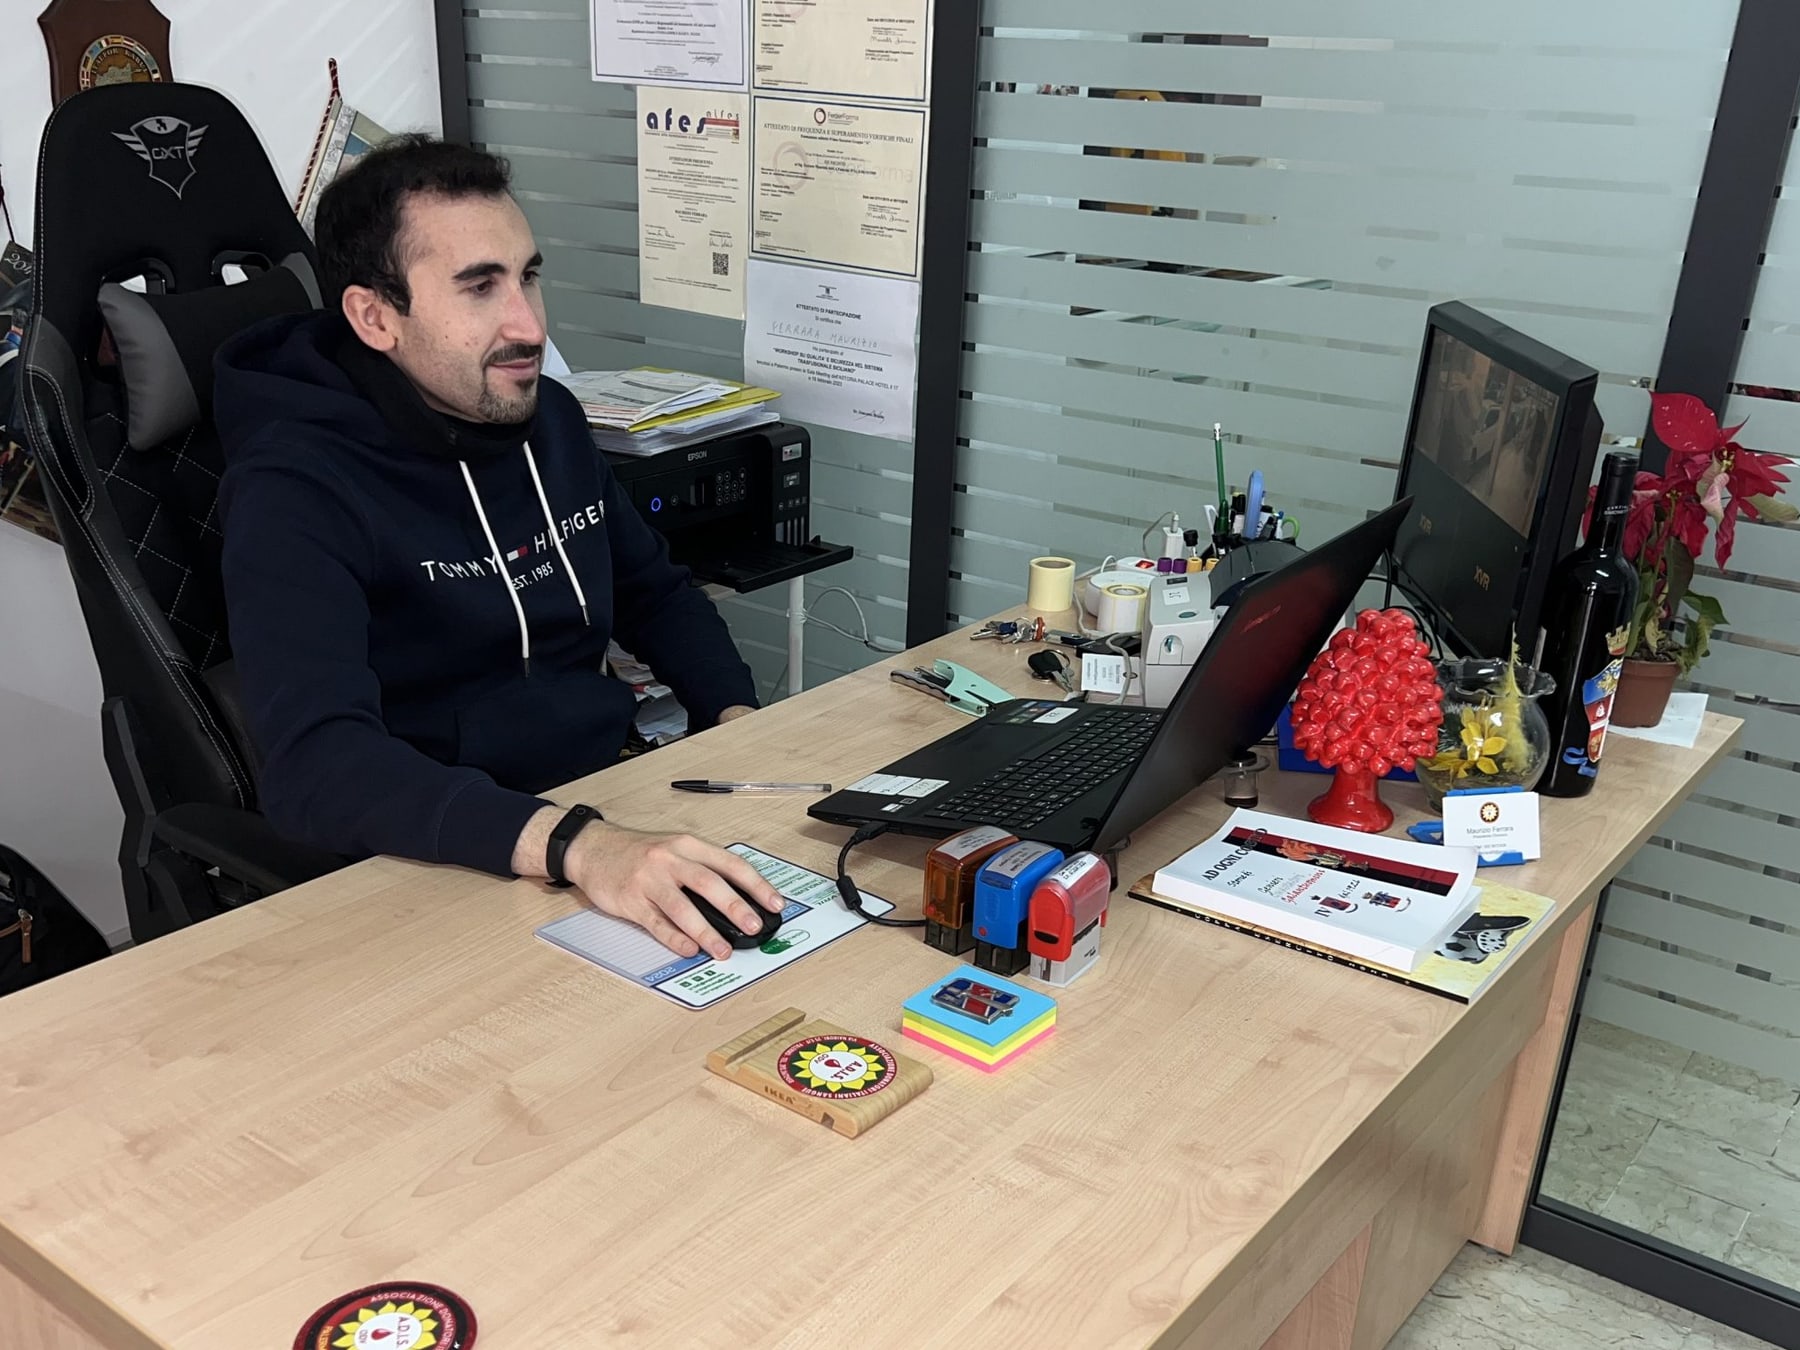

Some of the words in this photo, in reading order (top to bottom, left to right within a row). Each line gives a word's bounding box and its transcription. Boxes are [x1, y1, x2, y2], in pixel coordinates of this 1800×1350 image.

[646, 107, 706, 134] afes
[797, 126, 826, 135] FREQUENZA
[831, 129, 868, 139] SUPERAMENTO
[869, 133, 895, 141] VERIFICHE
[896, 136, 914, 144] FINALI
[152, 146, 185, 160] GXT
[795, 304, 819, 313] ATTESTATO
[825, 308, 861, 320] PARTECIPAZIONE
[797, 358, 832, 369] TRASFUSIONALE
[830, 357, 854, 367] SICUREZZA
[864, 363, 883, 372] SISTEMA
[687, 450, 708, 462] EPSON
[1419, 512, 1433, 537] XVR
[420, 554, 500, 582] TOMMY
[511, 575, 533, 592] EST.
[531, 561, 554, 582] 1985
[1473, 565, 1490, 591] XVR
[1202, 869, 1220, 881] AD
[1213, 854, 1243, 871] OGNI
[644, 966, 677, 982] 2024
[868, 1043, 897, 1072] ASSOCIAZIONE
[830, 1060, 863, 1080] A.D.I.S.
[801, 1087, 832, 1099] SANGUE
[868, 1071, 896, 1095] DONATORI
[764, 1085, 793, 1105] IKEA
[835, 1088, 869, 1099] ITALIANI
[370, 1291, 443, 1310] ASSOCIAZIONE
[439, 1307, 456, 1346] DONATORI
